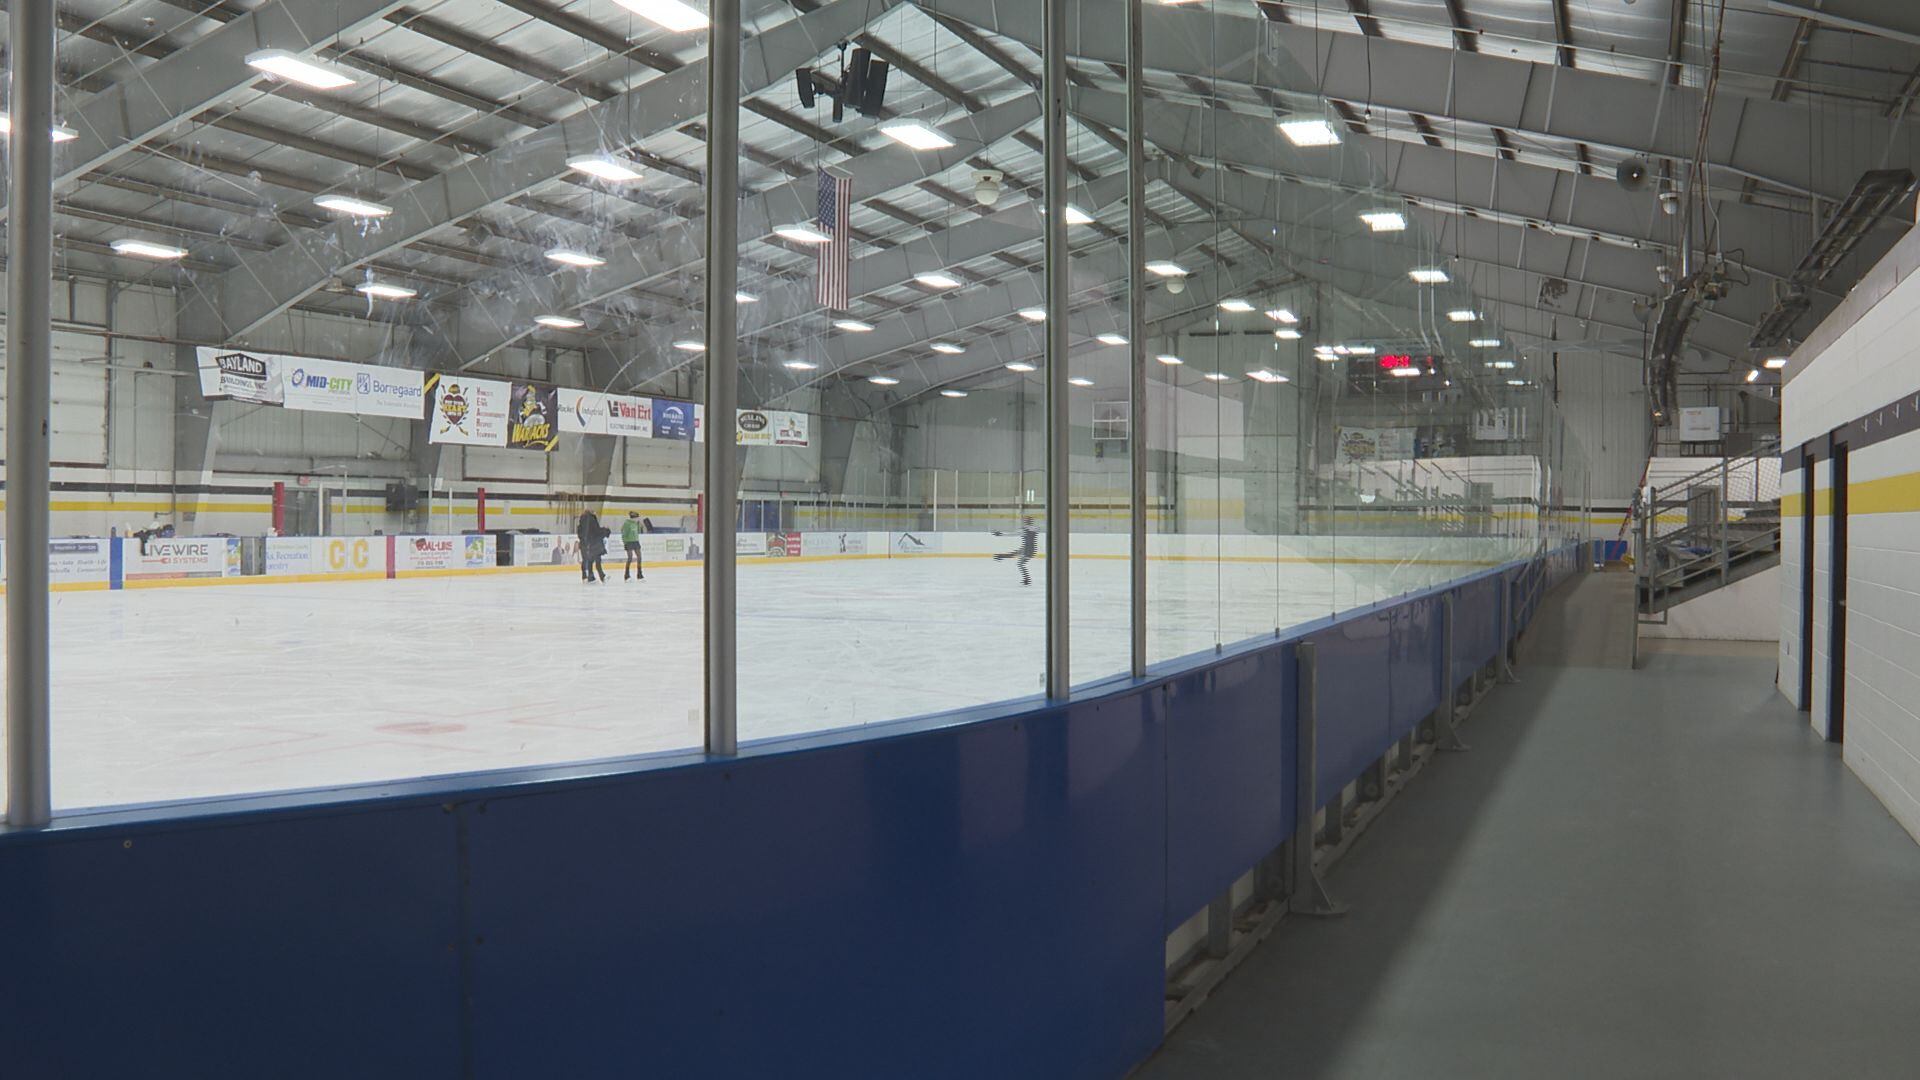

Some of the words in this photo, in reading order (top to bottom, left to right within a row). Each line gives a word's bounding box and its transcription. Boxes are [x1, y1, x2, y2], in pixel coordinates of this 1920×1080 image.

[219, 356, 263, 373] BAYLAND
[306, 375, 353, 391] MID-CITY
[373, 380, 422, 397] Borregaard
[619, 402, 636, 418] Van
[638, 404, 651, 420] Ert
[142, 544, 208, 556] LIVEWIRE
[172, 557, 208, 565] SYSTEMS
